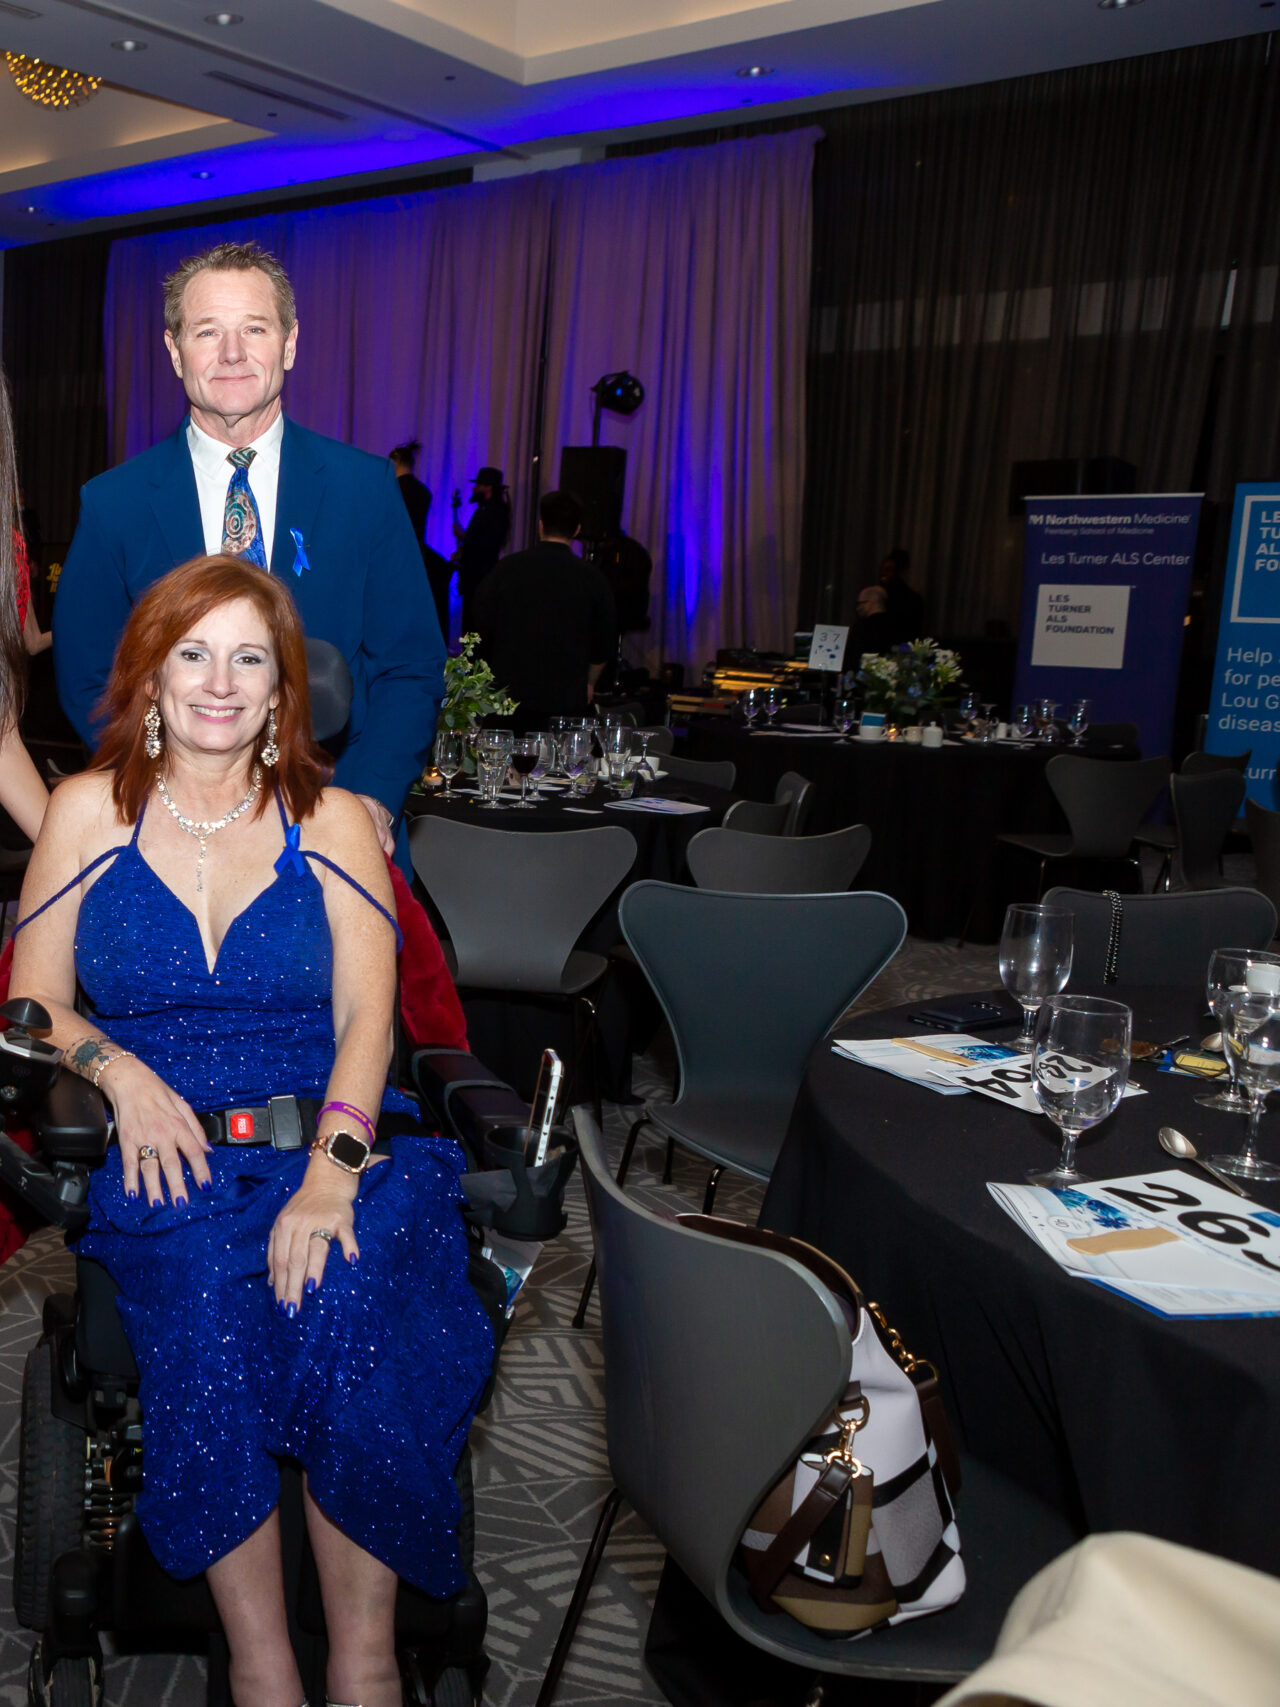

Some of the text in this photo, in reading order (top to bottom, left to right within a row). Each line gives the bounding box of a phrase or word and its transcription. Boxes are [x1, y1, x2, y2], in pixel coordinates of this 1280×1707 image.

[1045, 513, 1190, 526] Northwestern Medicine
[1256, 543, 1280, 556] AL
[1040, 552, 1190, 565] Les Turner ALS Center
[1254, 558, 1280, 572] FO
[1048, 594, 1070, 602] LES
[1048, 604, 1092, 613] TURNER
[1046, 615, 1068, 623] ALS
[1046, 624, 1115, 634] FOUNDATION
[1226, 647, 1272, 668] Help
[1224, 668, 1280, 690] for pe
[1221, 692, 1280, 710] Lou G
[1218, 713, 1280, 733] diseas
